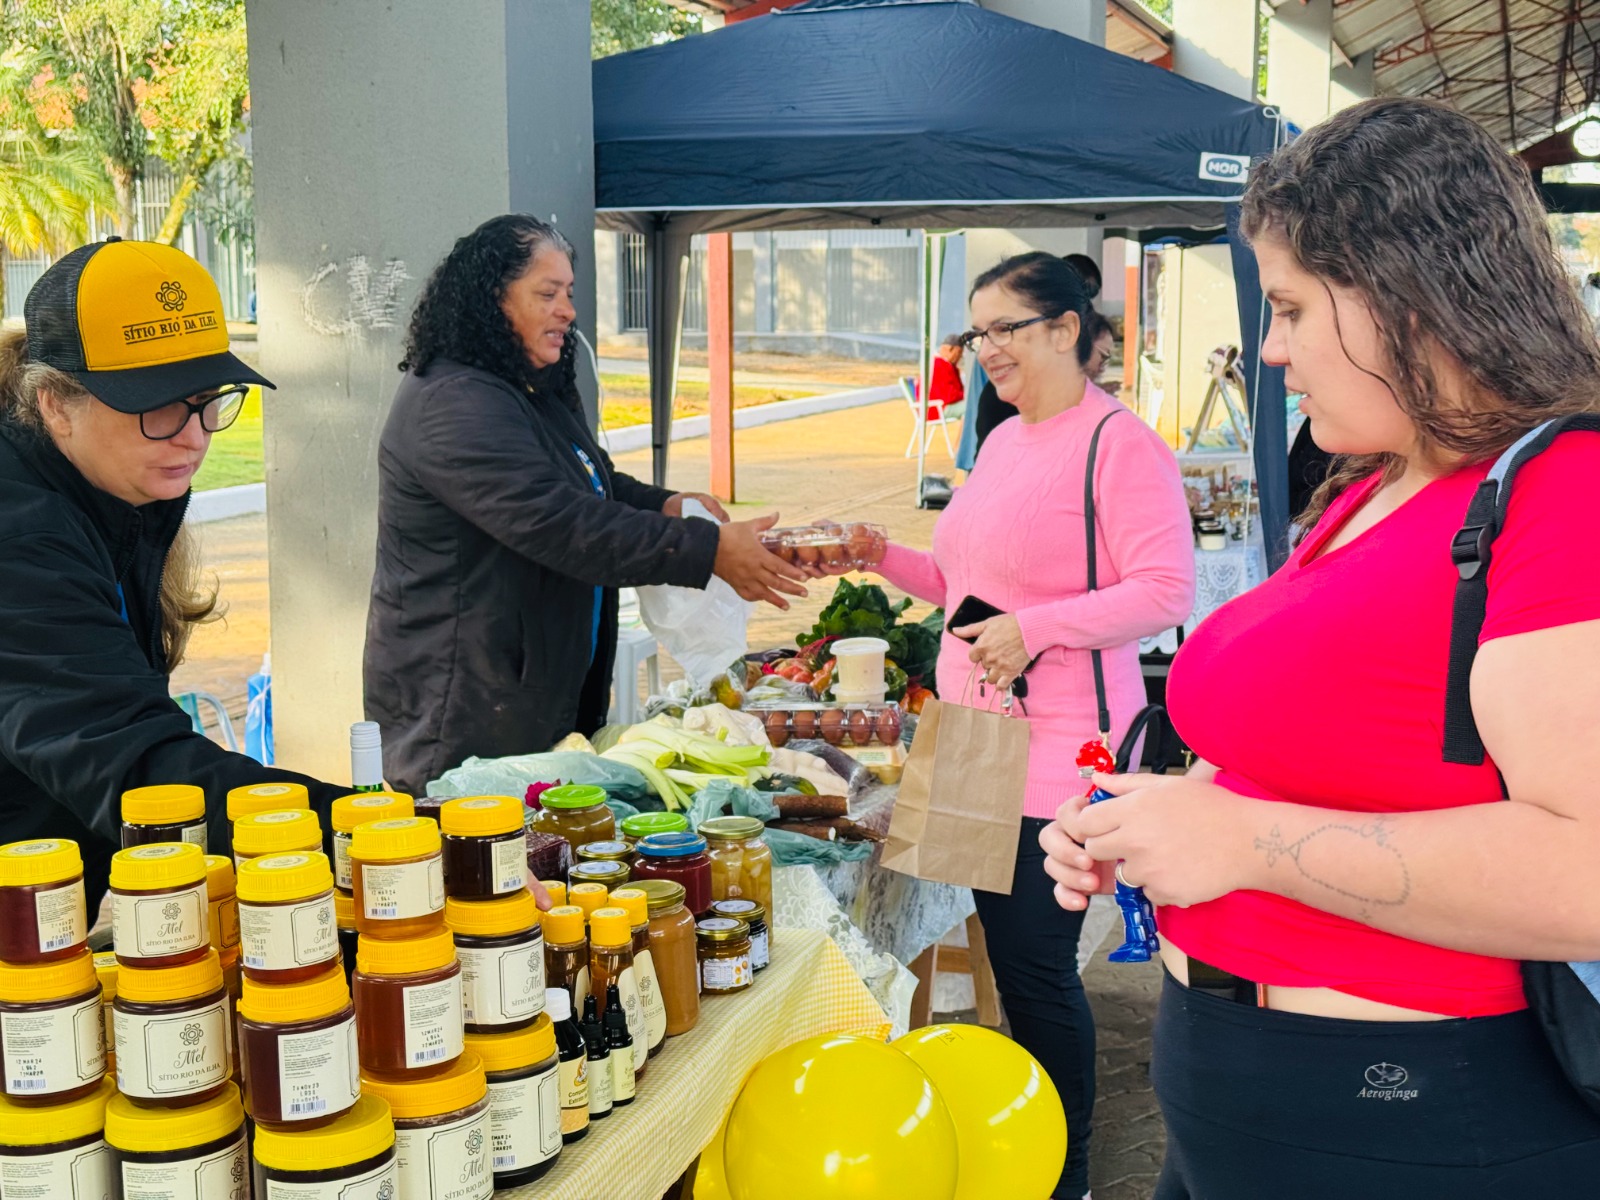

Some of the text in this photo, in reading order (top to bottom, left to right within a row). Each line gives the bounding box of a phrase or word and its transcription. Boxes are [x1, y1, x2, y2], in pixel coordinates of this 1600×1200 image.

[1208, 161, 1239, 174] MOR
[123, 315, 218, 341] SÍTIO RIO DA ILHA
[157, 920, 184, 937] Mel
[173, 1045, 207, 1069] Mel
[158, 1062, 221, 1081] SÍTIO RIO DA ILHA
[1357, 1086, 1419, 1101] Aeroginga
[459, 1153, 486, 1183] Mel
[444, 1189, 465, 1200] SÍTIO
